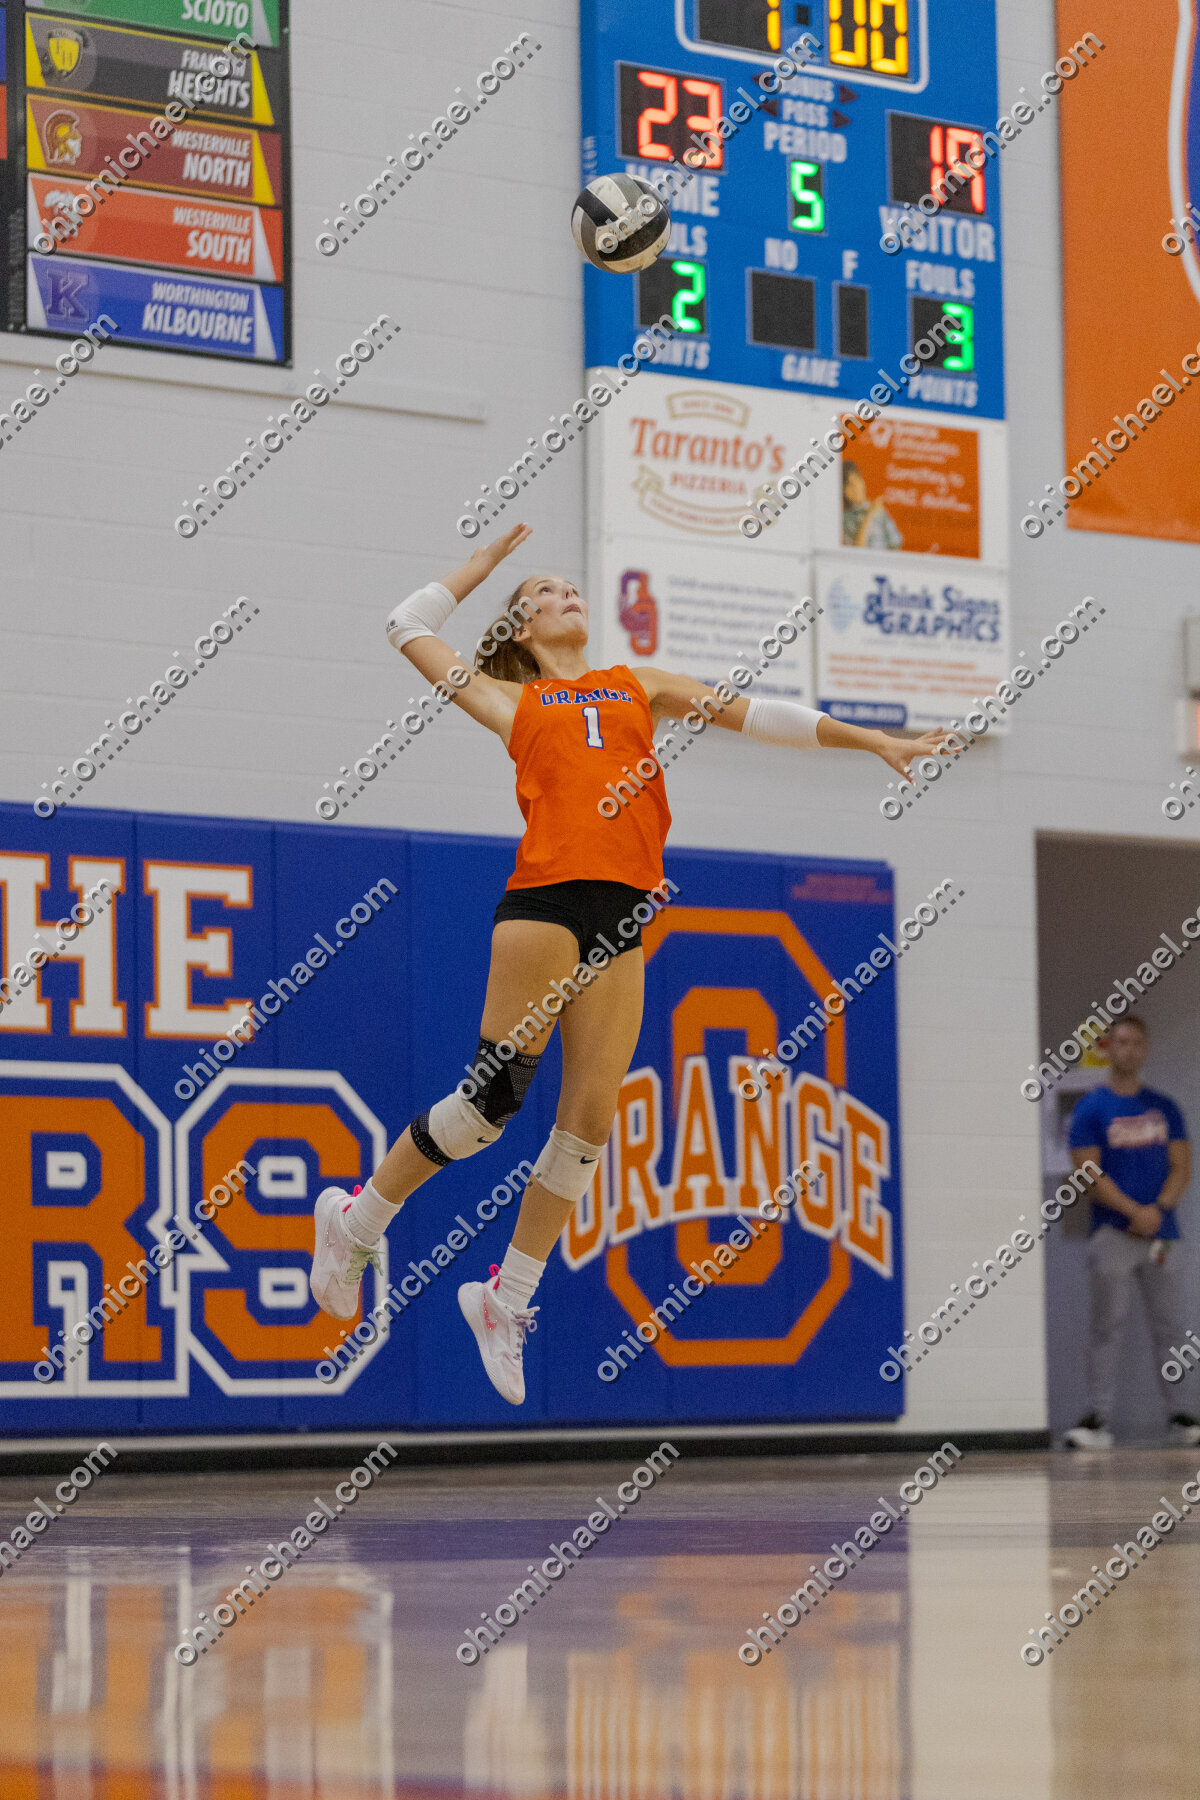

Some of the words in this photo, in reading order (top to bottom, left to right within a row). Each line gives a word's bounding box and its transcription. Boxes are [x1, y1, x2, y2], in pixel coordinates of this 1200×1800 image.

[181, 0, 249, 29] SCIOTO
[636, 71, 722, 168] 23
[782, 98, 829, 128] POSS
[171, 129, 250, 157] WESTERVILLE
[763, 121, 847, 163] PERIOD
[182, 153, 250, 188] NORTH
[930, 125, 986, 214] 19
[790, 161, 825, 231] 5
[173, 206, 251, 234] WESTERVILLE
[187, 230, 252, 265] SOUTH
[764, 237, 798, 271] NO
[842, 250, 859, 280] F
[152, 280, 250, 311] WORTHINGTON
[672, 260, 705, 333] 2
[906, 259, 975, 299] FOULS
[142, 303, 252, 344] KILBOURNE
[942, 302, 974, 372] 3
[781, 354, 841, 388] GAME
[907, 375, 979, 408] POINTS
[629, 416, 786, 475] Taranto's
[669, 473, 748, 495] PIZZERIA
[874, 575, 933, 610] Think
[942, 584, 1000, 619] Signs
[879, 613, 1001, 643] GRAPHICS
[581, 705, 604, 749] 1
